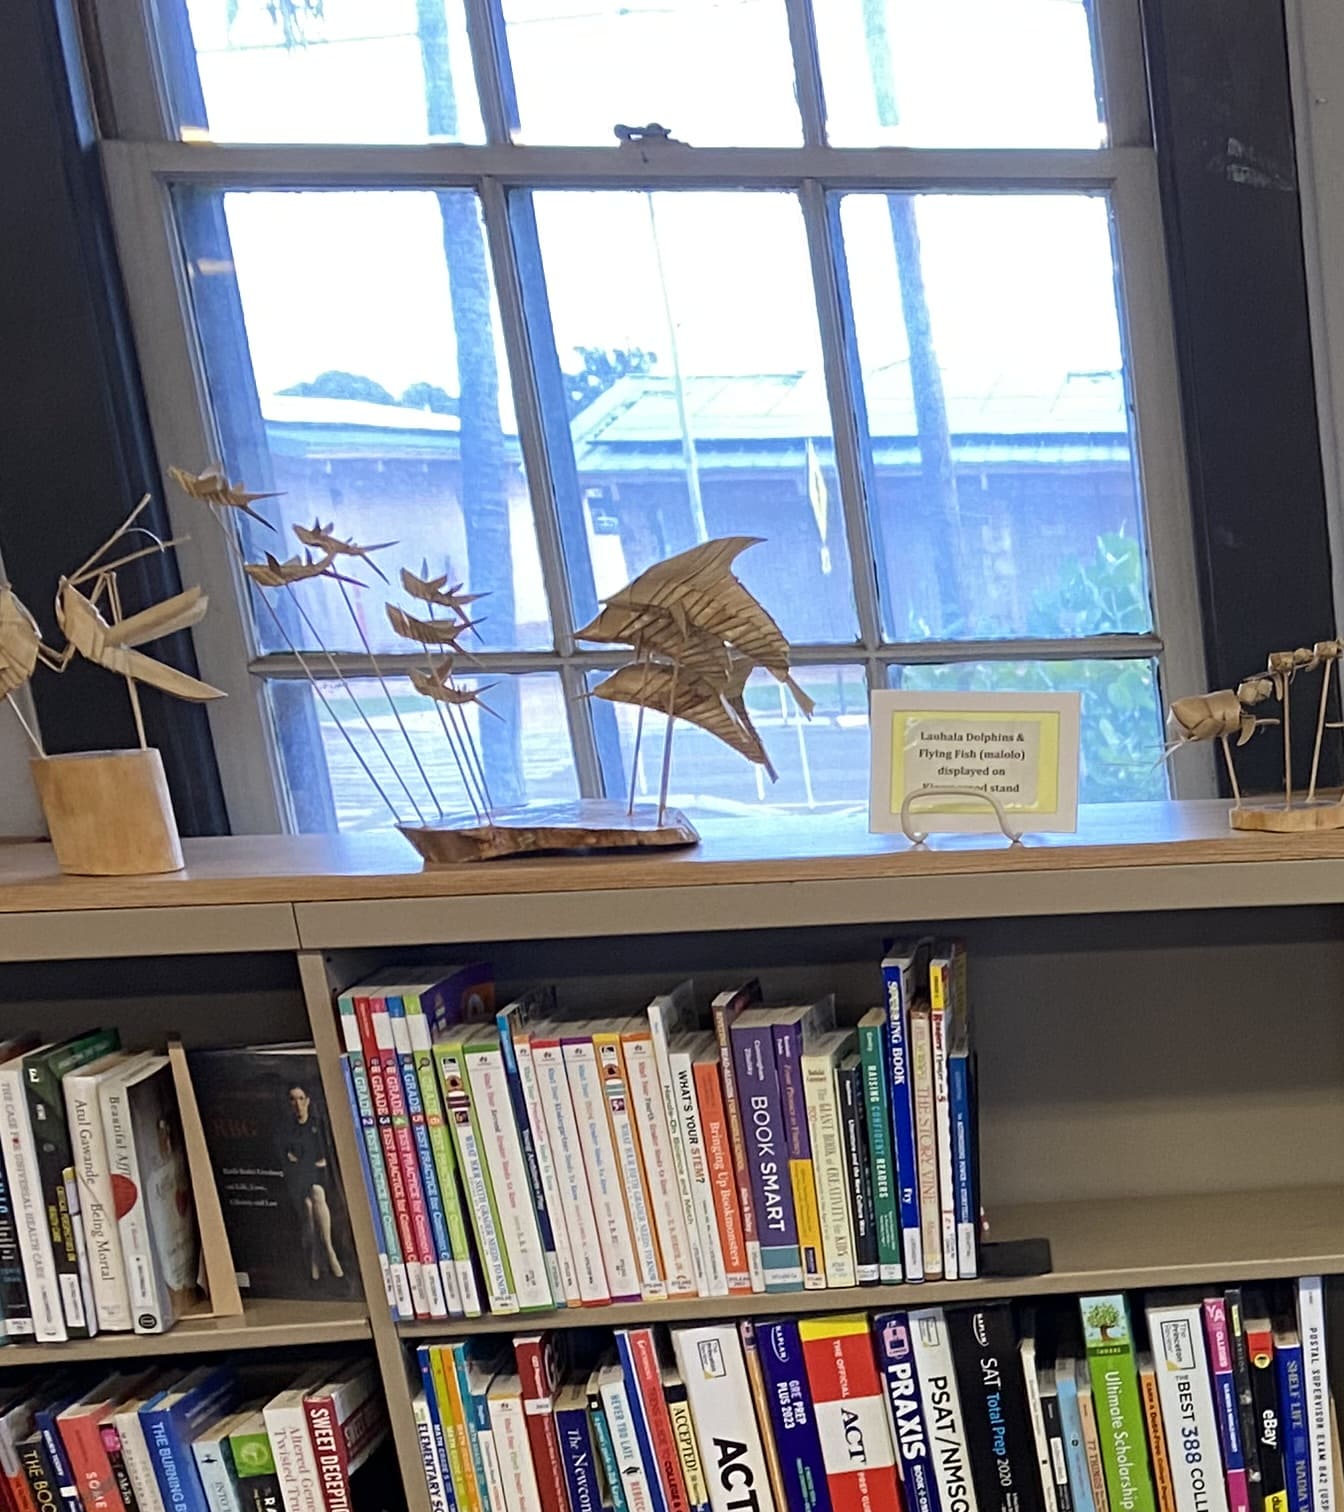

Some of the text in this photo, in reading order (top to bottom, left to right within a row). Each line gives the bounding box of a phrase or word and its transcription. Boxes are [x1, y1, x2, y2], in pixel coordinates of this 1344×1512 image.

[920, 749, 952, 759] Flying
[955, 750, 976, 758] Fish
[921, 732, 962, 741] Lauhala
[966, 733, 1014, 743] Dolphins
[938, 767, 989, 776] displayed
[990, 784, 1019, 792] stand
[751, 1097, 784, 1231] BOOK SMART
[310, 1409, 336, 1454] SWEET
[841, 1408, 866, 1465] ACT
[888, 1362, 926, 1460] PRAXIS
[981, 1359, 1012, 1486] SAT Total Prep 2020
[1178, 1382, 1202, 1464] BEST 388
[1262, 1410, 1277, 1447] eBay
[1105, 1371, 1124, 1428] Ultimate
[1115, 1431, 1138, 1509] Scholarship
